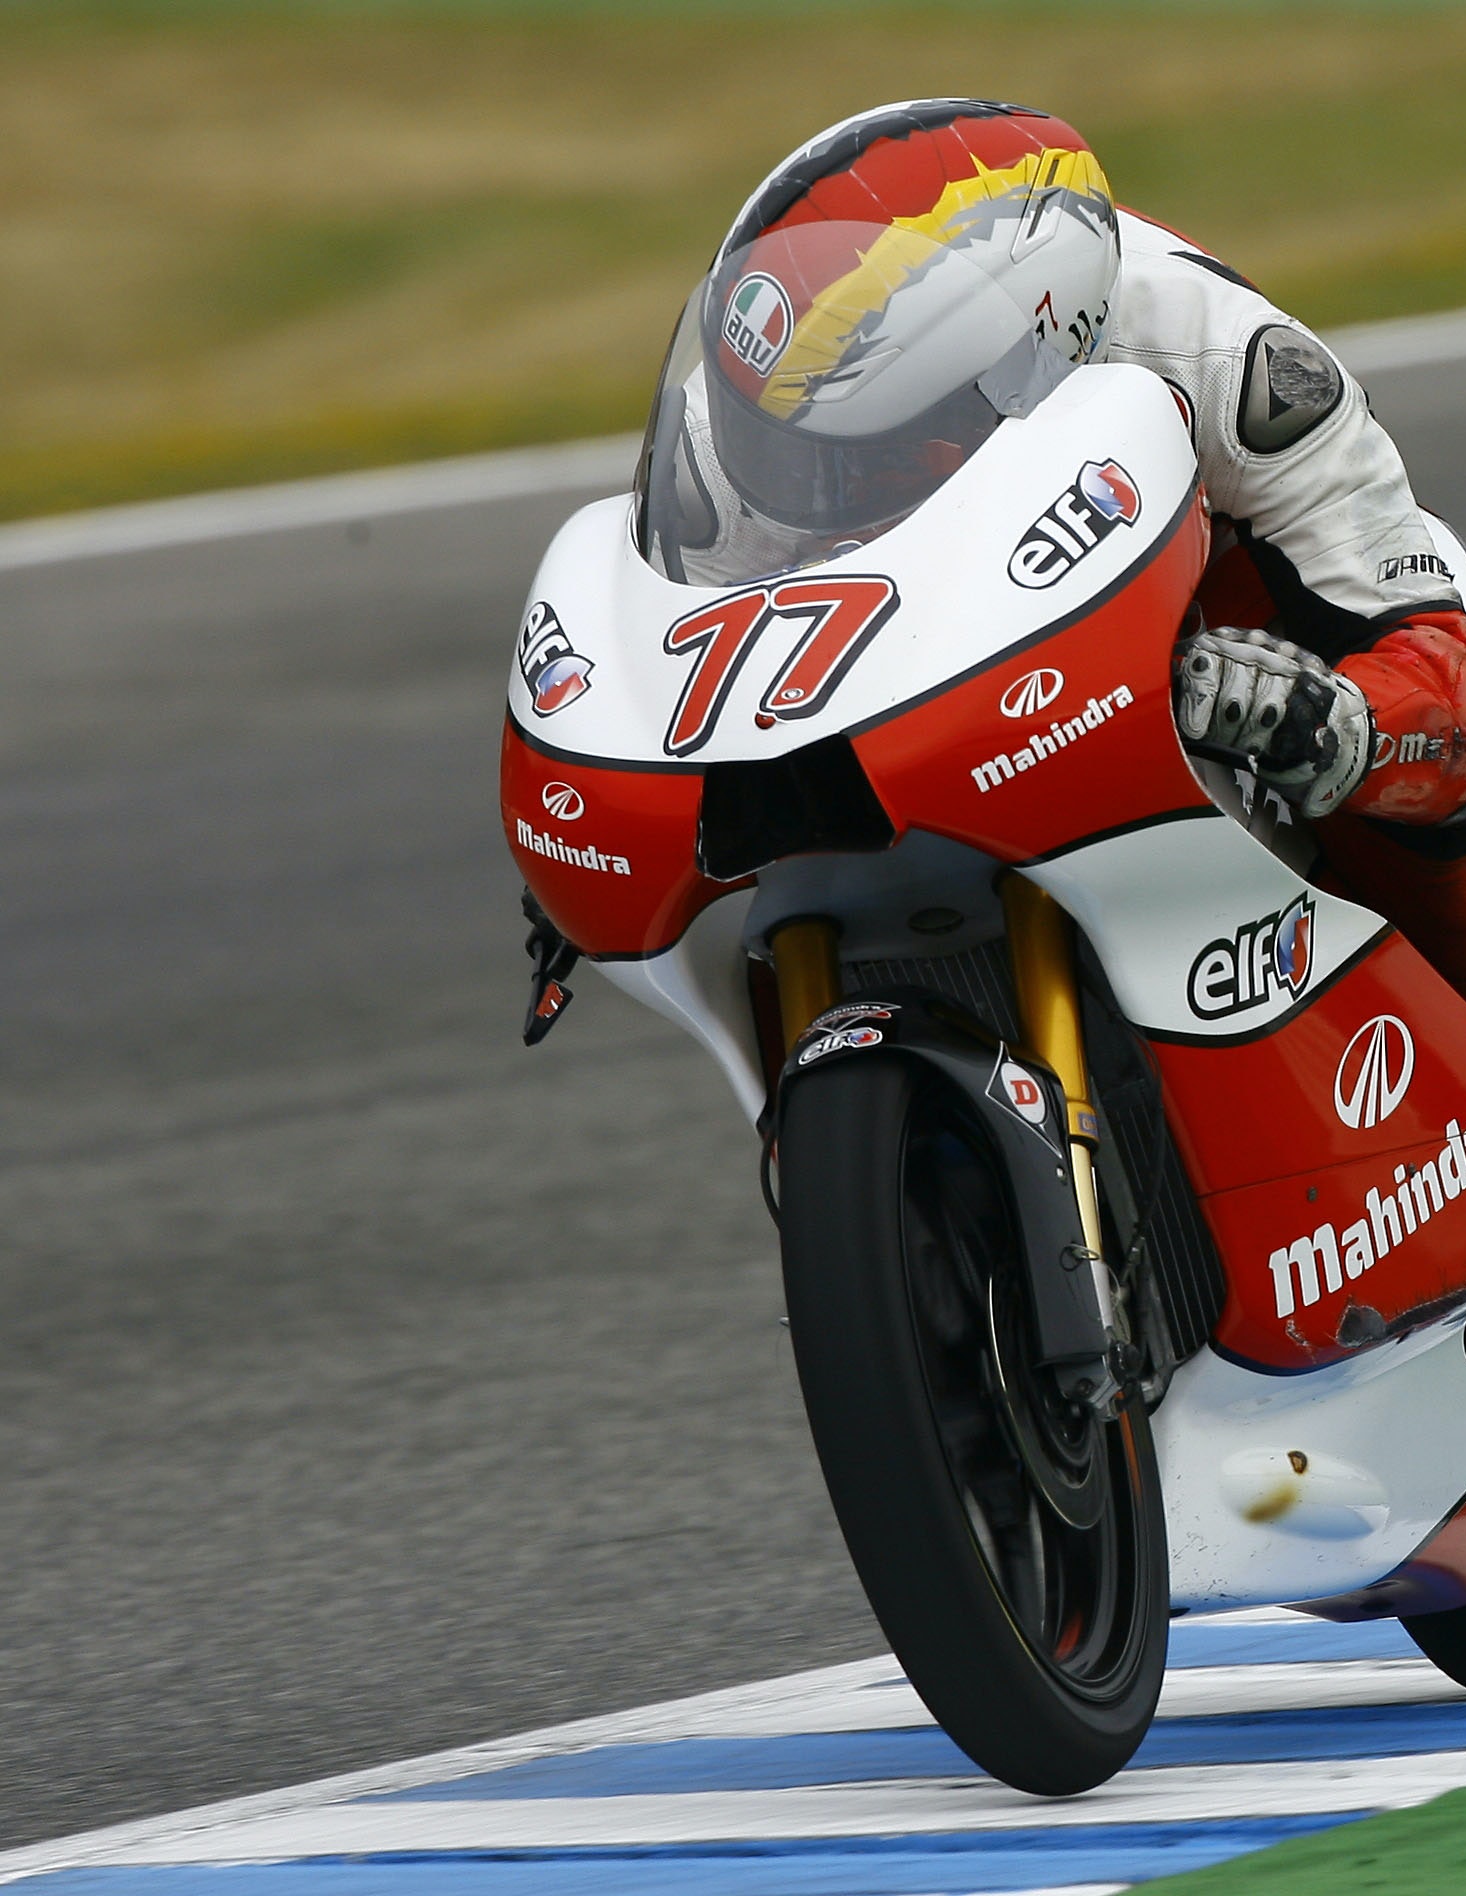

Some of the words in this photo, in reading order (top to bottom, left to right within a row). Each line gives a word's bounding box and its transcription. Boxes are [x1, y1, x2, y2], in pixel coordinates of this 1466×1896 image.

[1009, 490, 1103, 589] elf
[520, 602, 571, 680] elf
[970, 683, 1135, 794] Mahindra
[516, 818, 631, 876] Mahindra
[1192, 920, 1278, 1014] elf
